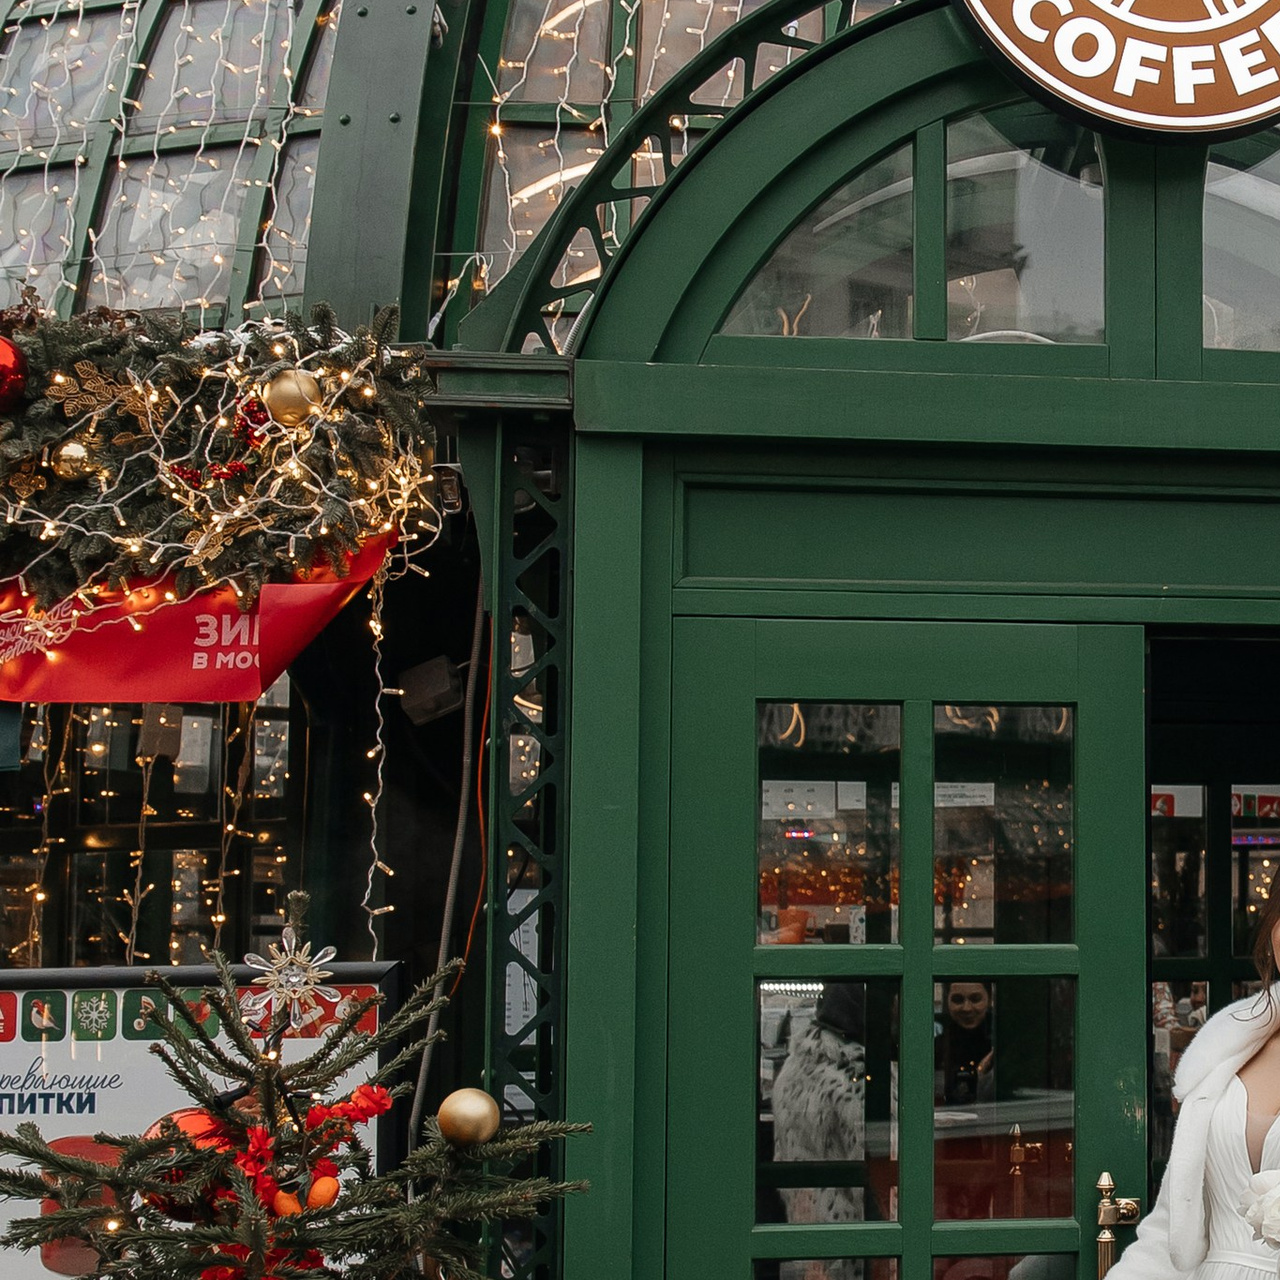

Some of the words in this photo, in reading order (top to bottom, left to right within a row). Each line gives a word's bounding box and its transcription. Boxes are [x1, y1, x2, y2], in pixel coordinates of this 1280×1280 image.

[193, 613, 260, 648] ЗИ
[192, 651, 208, 670] В
[0, 1092, 96, 1115] ПИТКИ
